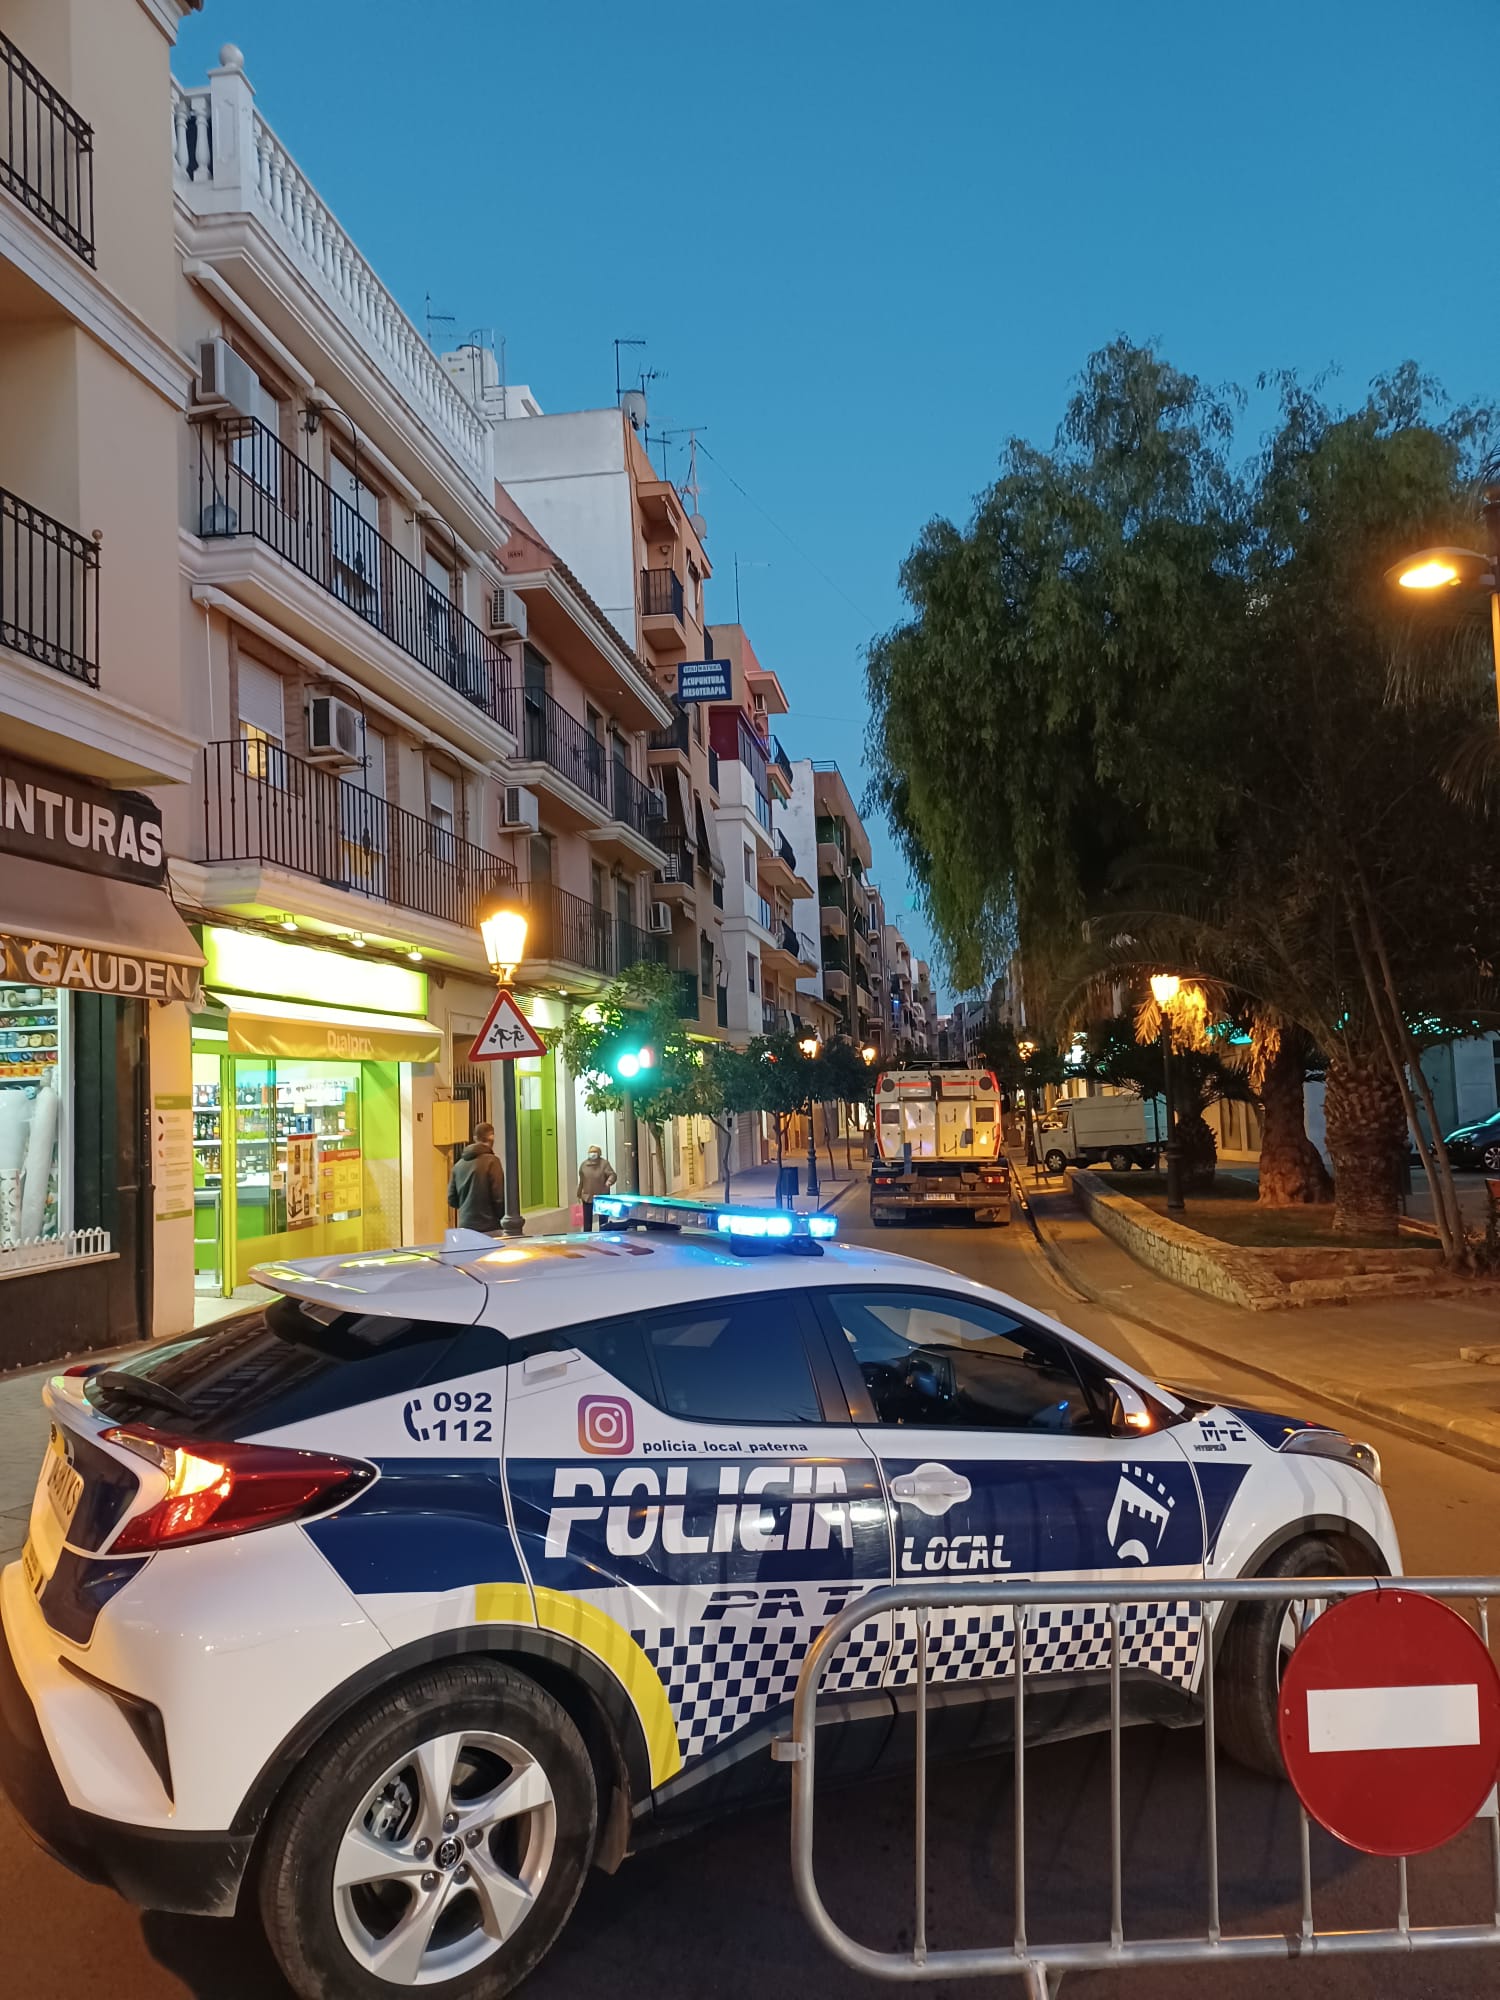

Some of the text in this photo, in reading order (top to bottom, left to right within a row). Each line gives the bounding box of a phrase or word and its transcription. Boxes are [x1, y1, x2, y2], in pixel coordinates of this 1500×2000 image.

[682, 675, 725, 686] ACUPUNTURA
[682, 686, 727, 697] MESOTERAPIA
[0, 776, 162, 867] NTURAS
[433, 1392, 492, 1412] 092
[432, 1420, 492, 1441] 112
[642, 1440, 809, 1454] policia_local_paterna
[545, 1466, 854, 1559] POLICIA
[901, 1534, 1013, 1572] LOCAL
